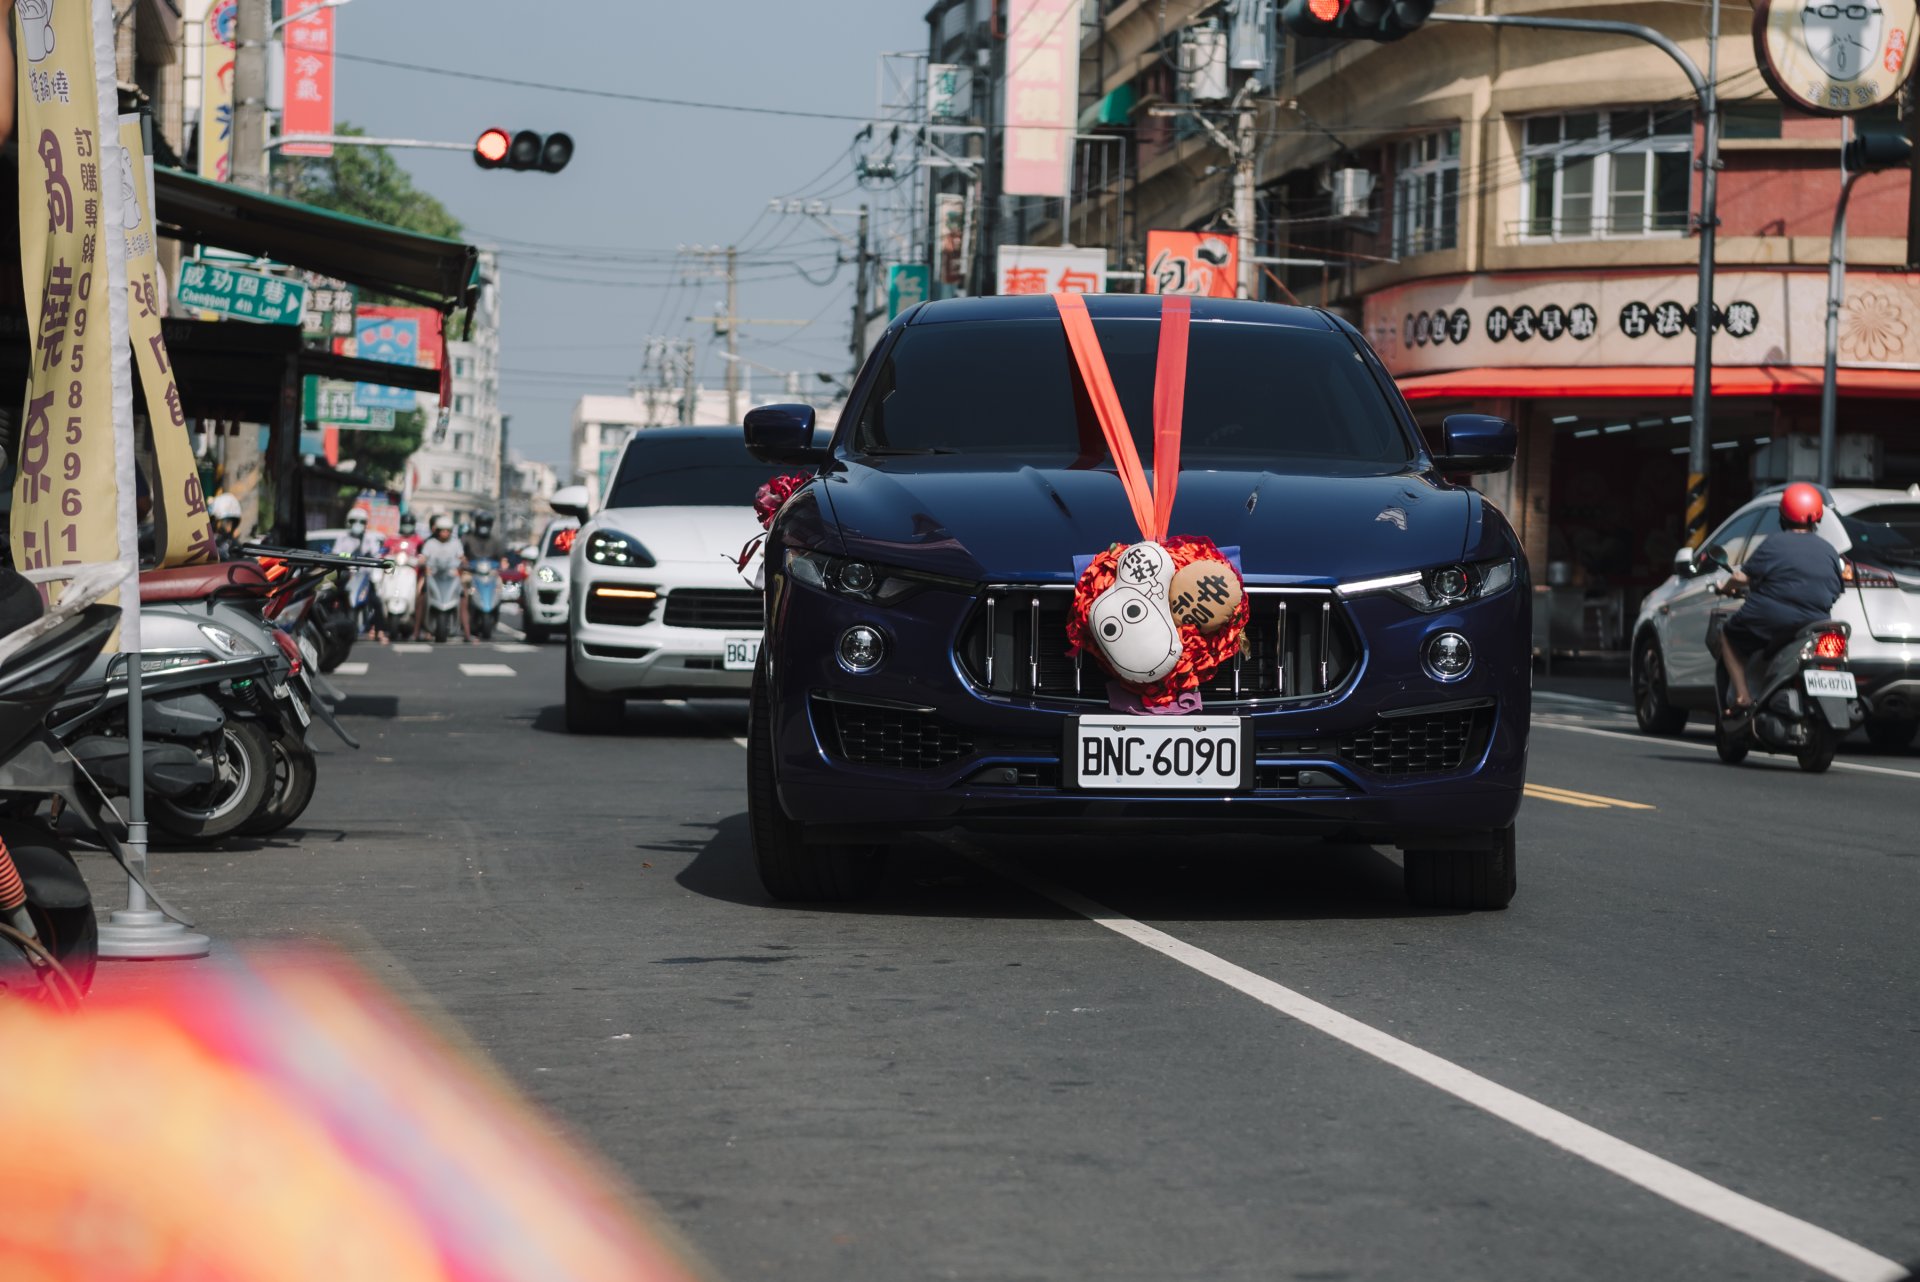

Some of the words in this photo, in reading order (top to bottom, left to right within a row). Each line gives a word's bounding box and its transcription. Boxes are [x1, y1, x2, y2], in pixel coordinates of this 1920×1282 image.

[294, 55, 325, 102] 冷氣
[183, 265, 287, 304] 成功四巷
[181, 287, 231, 311] Chenggong
[234, 298, 254, 313] 4th
[257, 302, 282, 320] Lane
[1488, 306, 1595, 339] 中式早點
[1622, 303, 1757, 336] 古法漿
[1121, 548, 1159, 583] 你好
[1172, 574, 1230, 629] 幸福
